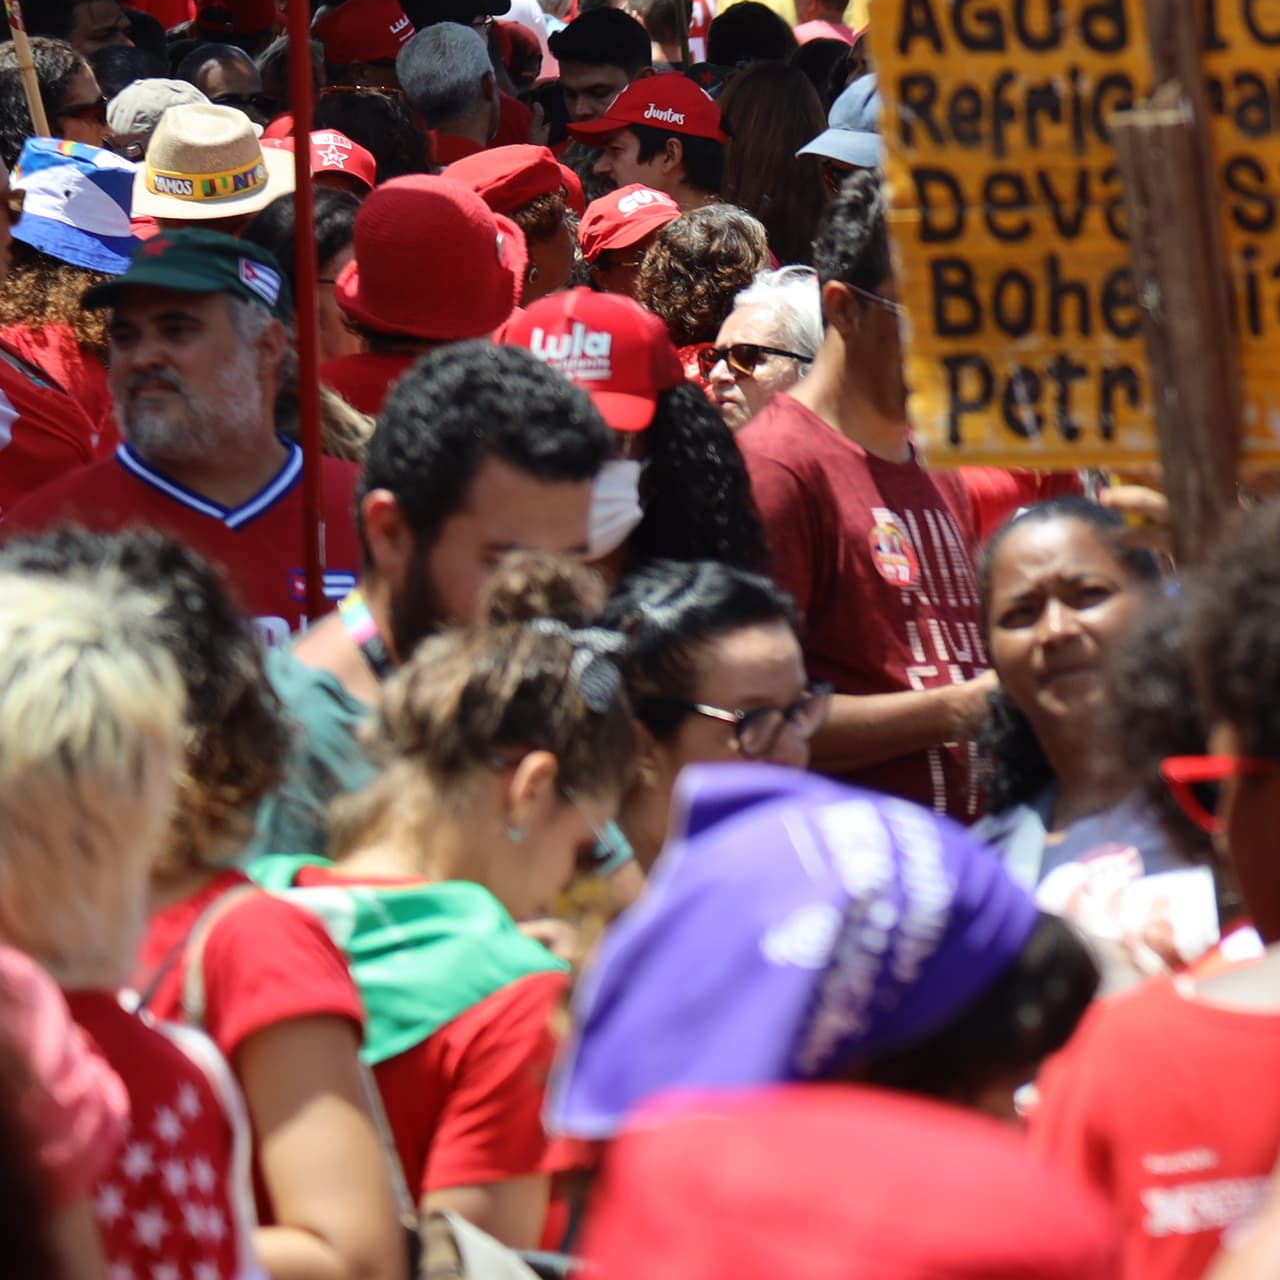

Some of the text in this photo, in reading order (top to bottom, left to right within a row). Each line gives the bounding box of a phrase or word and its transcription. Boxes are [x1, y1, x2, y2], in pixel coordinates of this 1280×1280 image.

[643, 103, 686, 125] Juntas
[530, 322, 612, 361] Lula
[941, 352, 1143, 446] Petr
